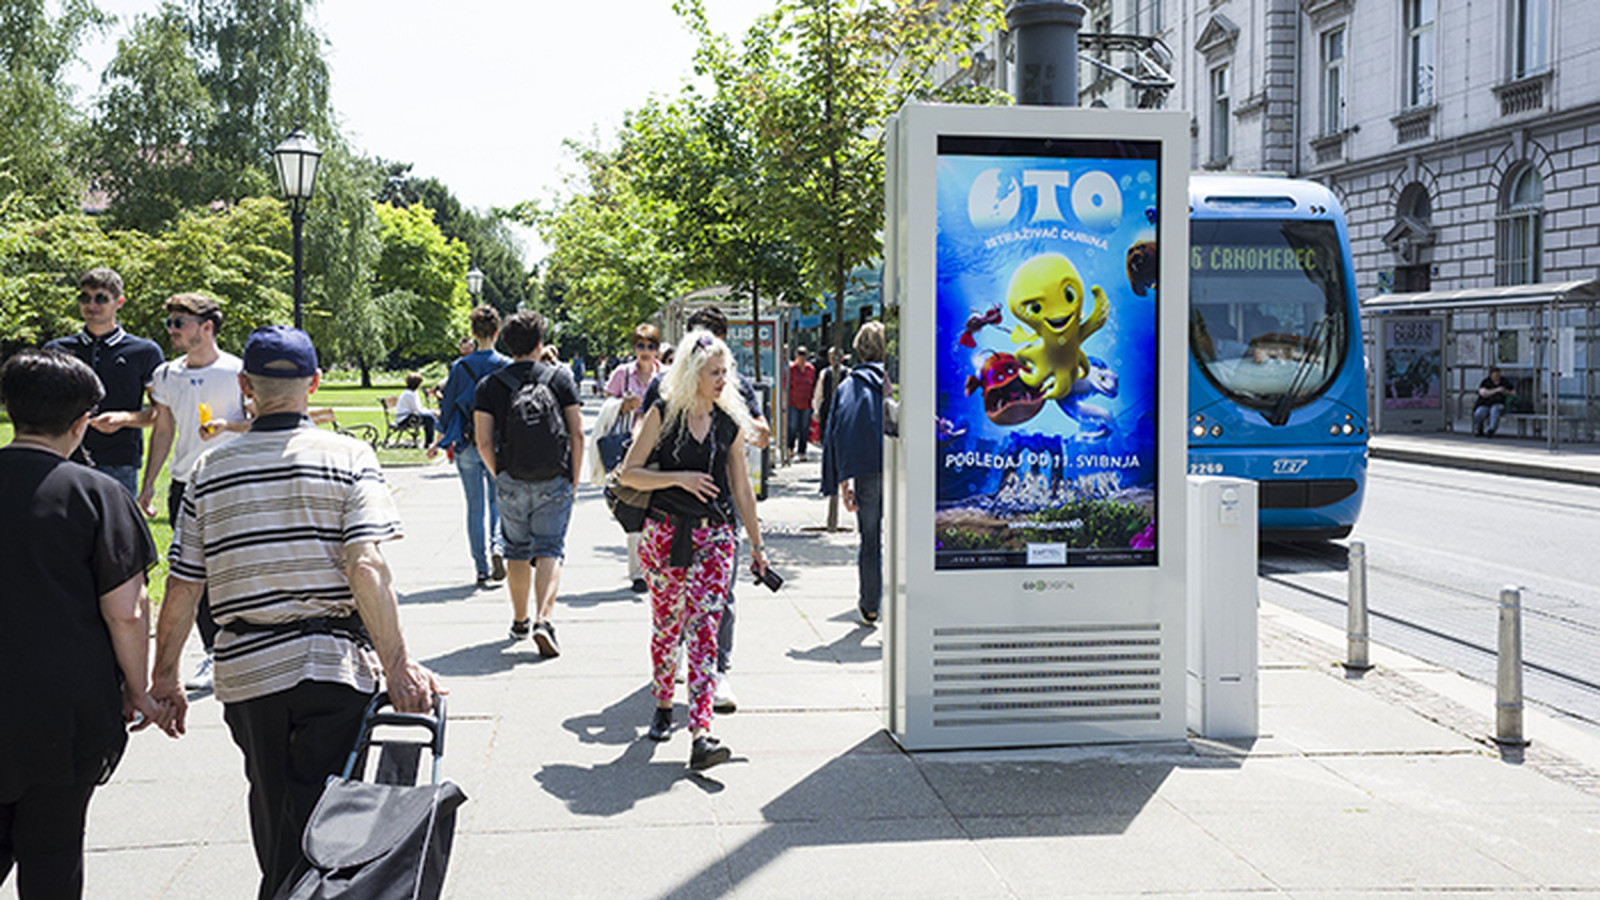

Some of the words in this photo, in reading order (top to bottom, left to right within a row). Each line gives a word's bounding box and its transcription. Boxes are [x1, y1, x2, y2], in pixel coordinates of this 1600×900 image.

[968, 168, 1123, 233] OTO
[1061, 228, 1109, 251] DUBINA
[945, 451, 1023, 470] POGLEDAJ
[1027, 452, 1049, 466] OD
[1052, 454, 1073, 468] 11.
[1076, 454, 1140, 469] SVIBNJA
[1190, 462, 1224, 474] 2269
